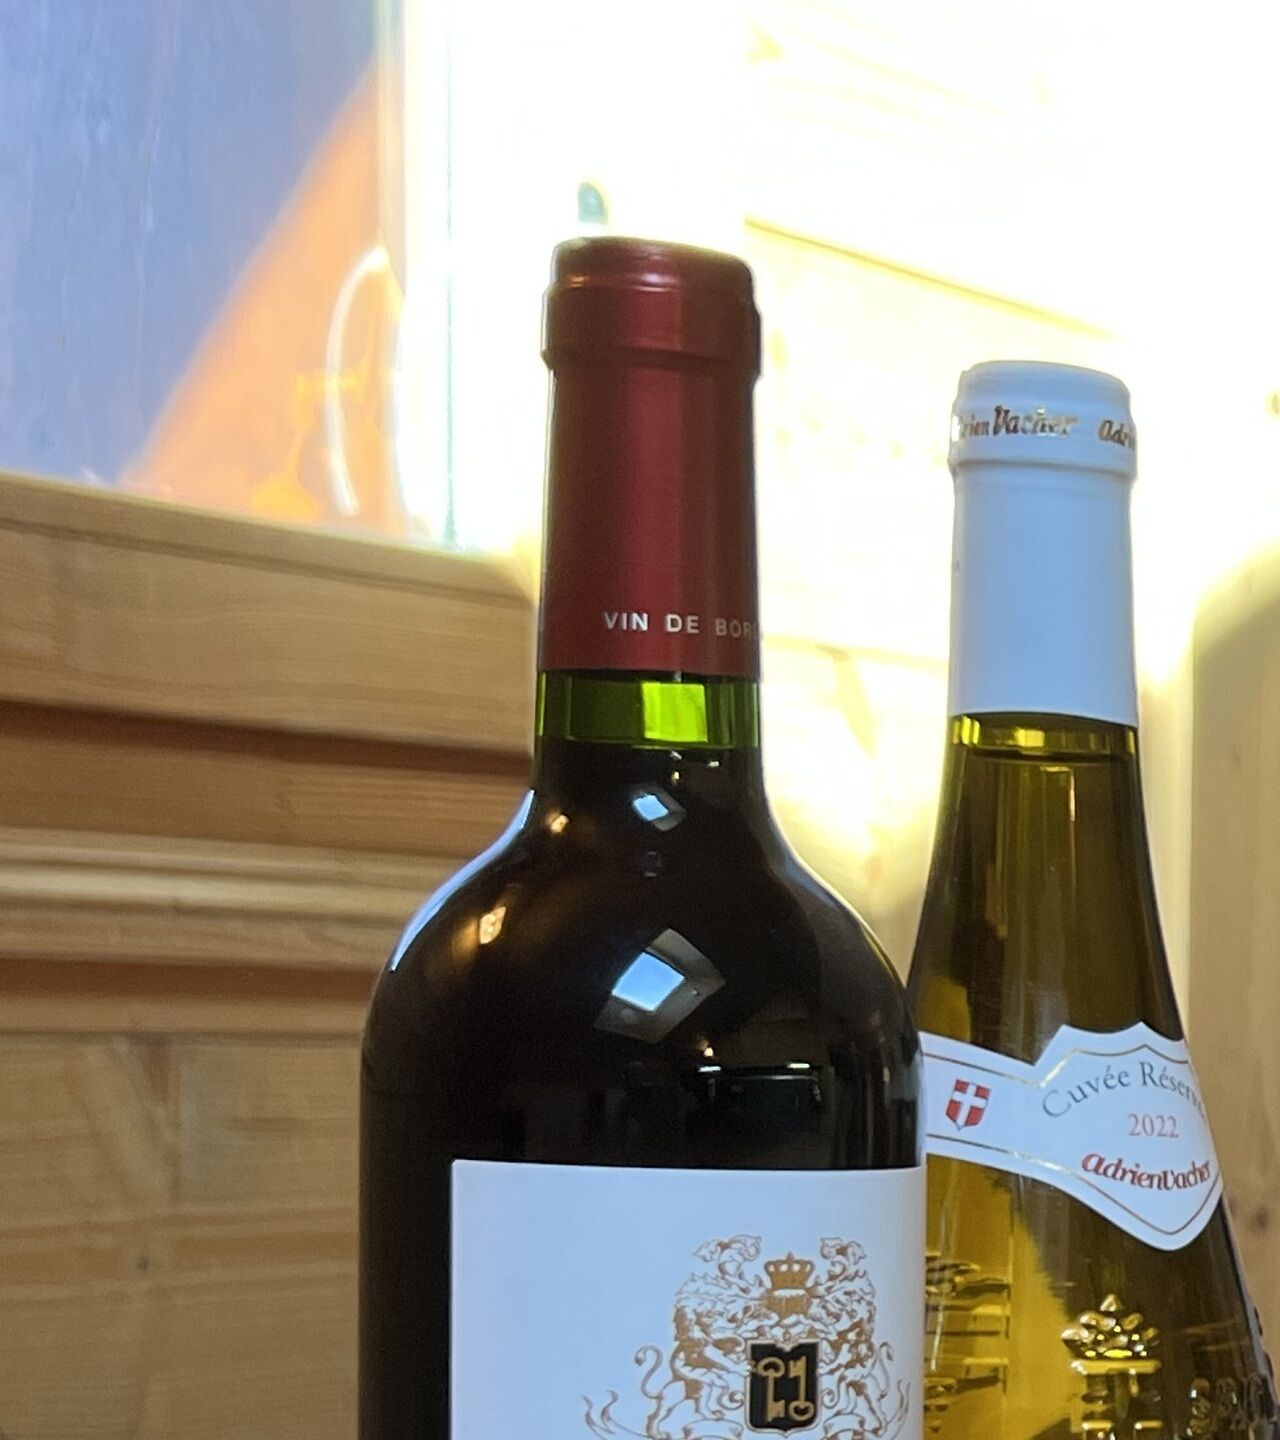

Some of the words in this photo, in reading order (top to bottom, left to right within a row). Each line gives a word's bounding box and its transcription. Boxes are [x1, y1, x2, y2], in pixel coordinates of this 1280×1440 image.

[604, 612, 648, 631] VIN
[665, 613, 700, 633] DE
[715, 618, 757, 639] BOR
[1042, 1065, 1131, 1117] Cuvée
[1128, 1113, 1179, 1139] 2022
